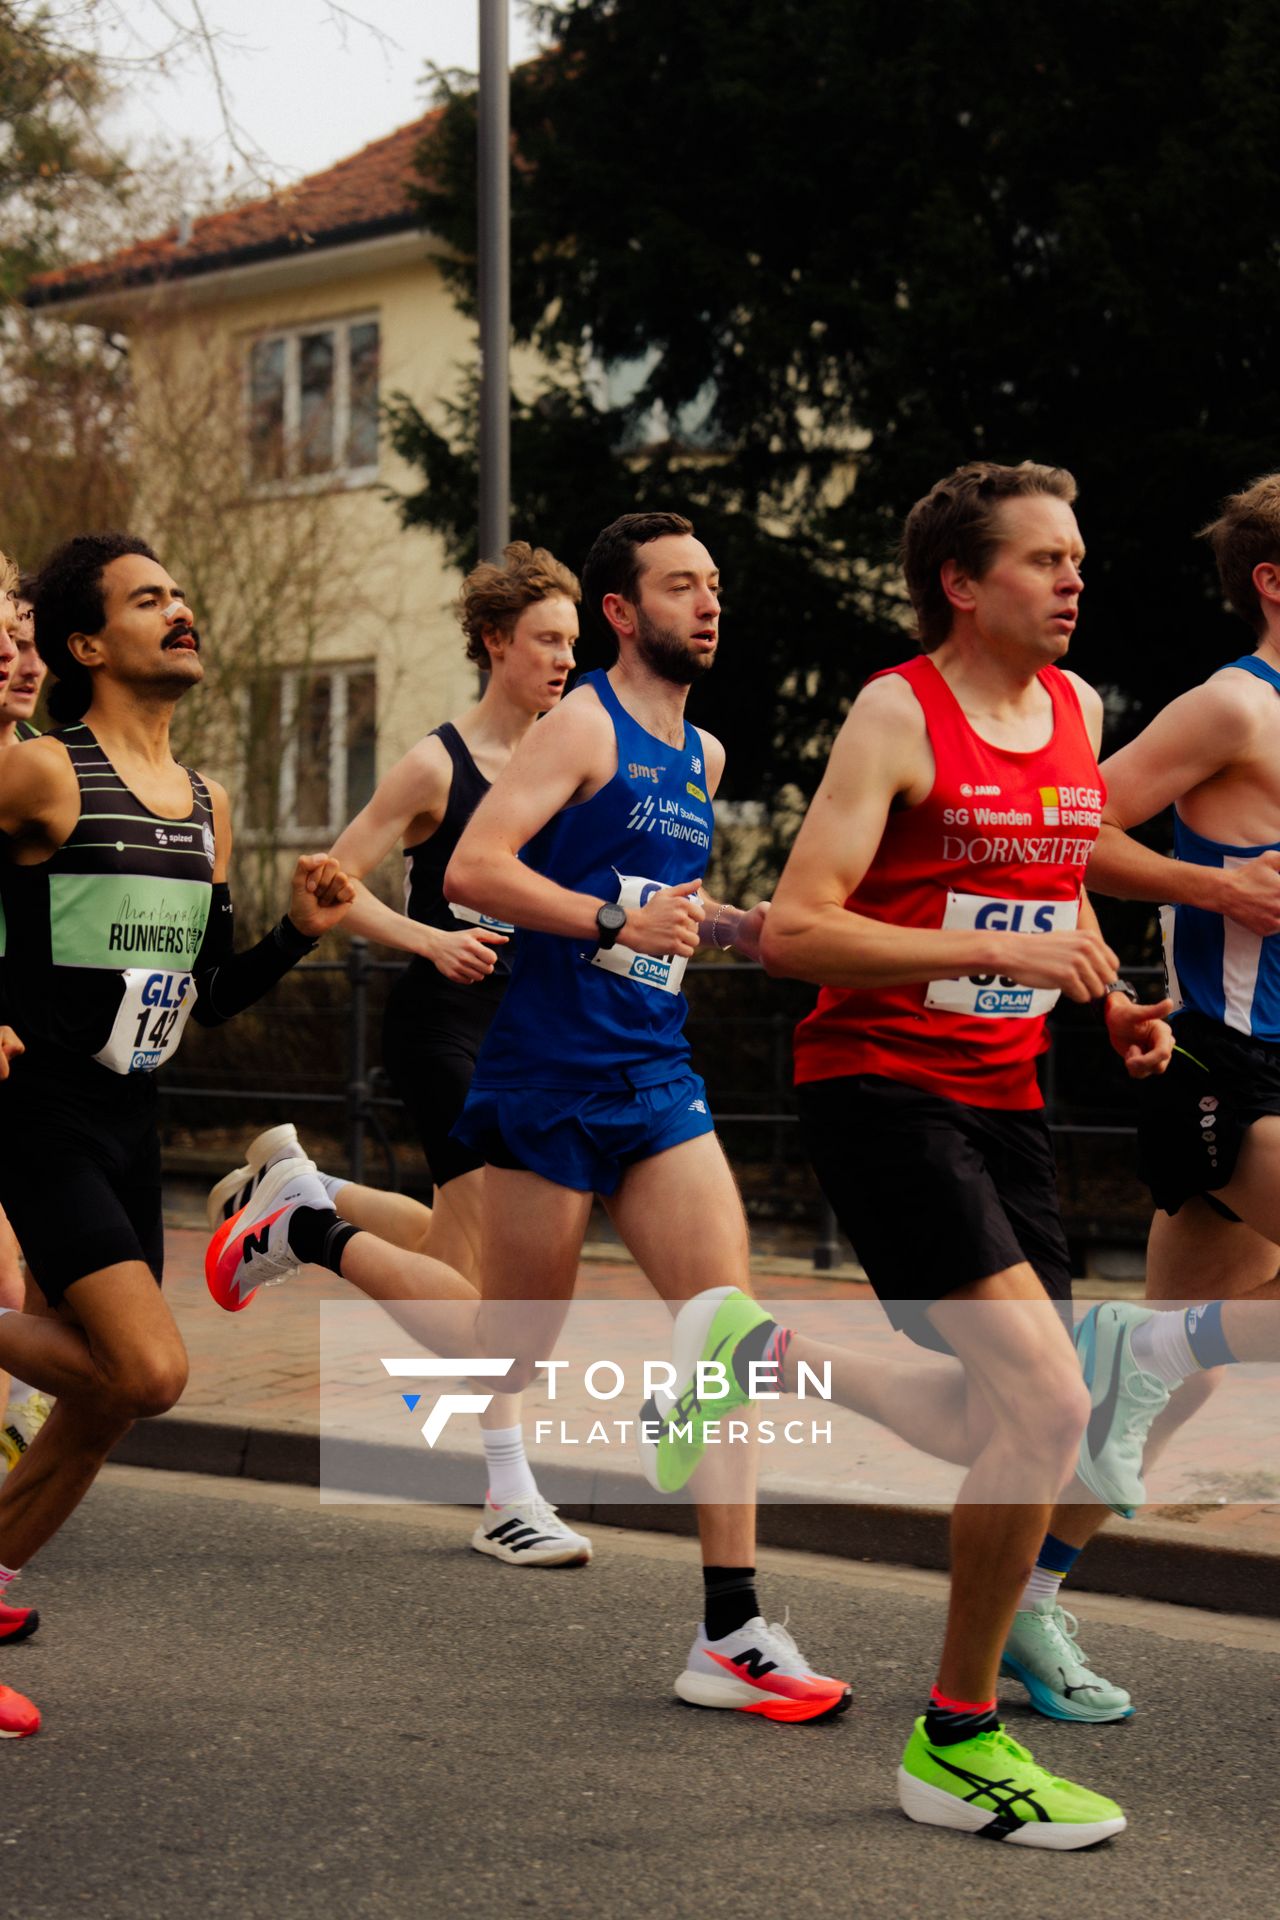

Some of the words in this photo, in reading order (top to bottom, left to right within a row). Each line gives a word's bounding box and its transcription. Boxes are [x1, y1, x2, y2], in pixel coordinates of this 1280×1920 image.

[974, 785, 1001, 796] JAKO
[1058, 786, 1102, 810] BIGGE
[659, 797, 678, 816] LAV
[943, 808, 969, 826] SG
[973, 807, 1032, 826] Wenden
[169, 833, 193, 843] spized
[660, 817, 710, 850] TÜBINGEN
[108, 923, 184, 954] RUNNERS
[650, 964, 670, 977] PLAN
[141, 973, 191, 1008] GLS
[1000, 994, 1031, 1006] PLAN
[133, 1008, 179, 1048] 142
